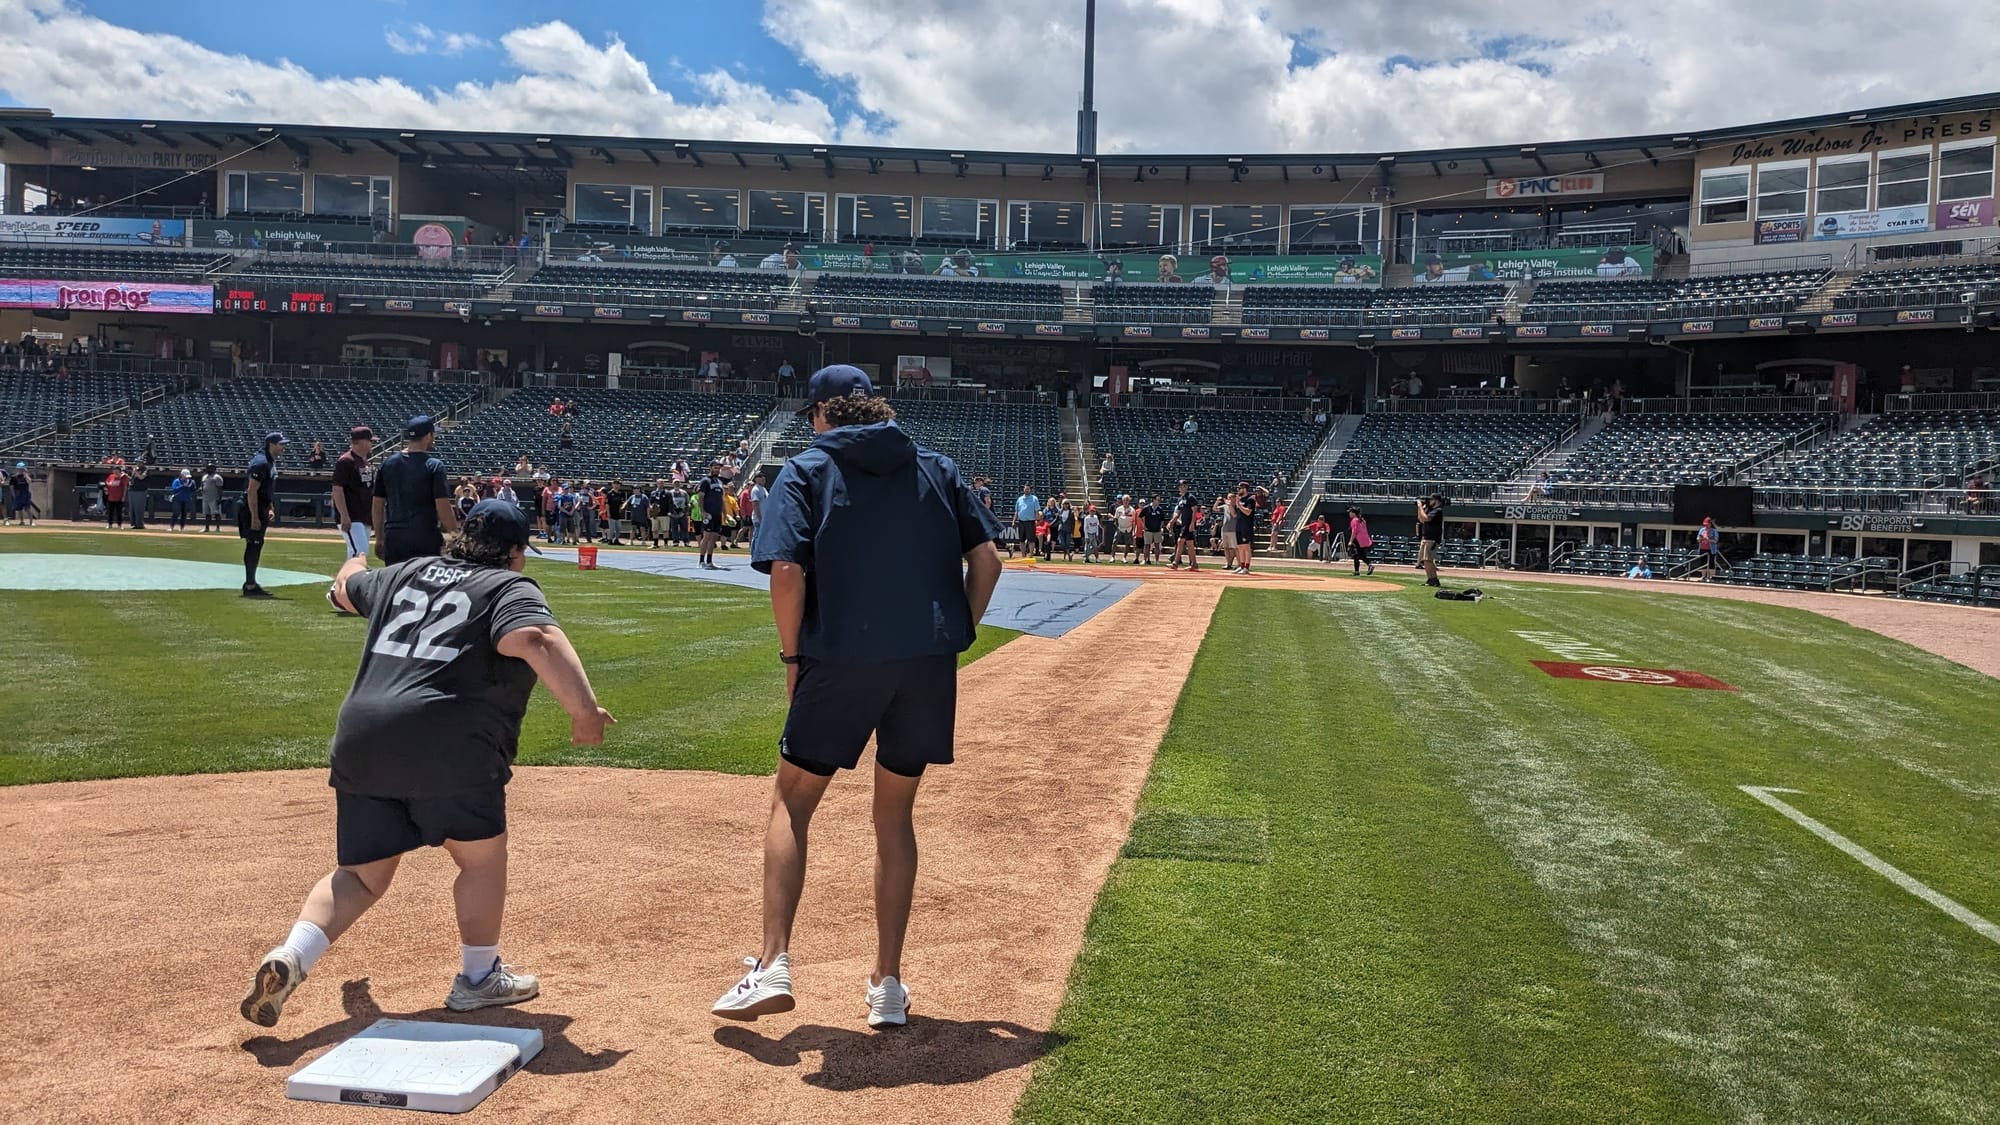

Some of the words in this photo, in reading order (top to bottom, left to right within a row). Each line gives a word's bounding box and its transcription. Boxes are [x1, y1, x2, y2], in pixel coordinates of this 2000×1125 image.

[1729, 143, 1775, 166] John
[1781, 138, 1853, 156] Walson
[1903, 119, 1992, 143] PRESS
[153, 152, 182, 167] PARTY
[185, 153, 217, 168] PORCH
[1519, 177, 1560, 194] PNC
[55, 221, 100, 231] SPEED
[1773, 220, 1800, 231] SPORTS
[265, 230, 295, 241] Lehigh
[295, 231, 321, 242] Valley
[1024, 262, 1046, 270] Lehigh
[1046, 263, 1066, 271] Valley
[1267, 264, 1289, 273] Lehigh
[1289, 264, 1309, 273] Valley
[1498, 259, 1529, 270] Lehigh
[1530, 258, 1559, 269] Valley
[1062, 270, 1089, 278] Instiute
[215, 300, 222, 309] R
[234, 300, 240, 309] H
[282, 301, 288, 311] R
[301, 302, 307, 311] H
[1832, 314, 1856, 324] NEWS
[1908, 310, 1934, 319] NEWS
[1692, 322, 1713, 331] NEWS
[1760, 318, 1782, 327] NEWS
[1461, 328, 1481, 336] NEWS
[1525, 327, 1546, 335] NEWS
[1591, 325, 1612, 334] NEWS
[1527, 506, 1573, 515] CORPORATE
[1531, 513, 1568, 521] BENEFITS
[1865, 515, 1918, 525] CORPORATE
[1871, 523, 1912, 533] BENEFITS
[372, 586, 471, 662] 22
